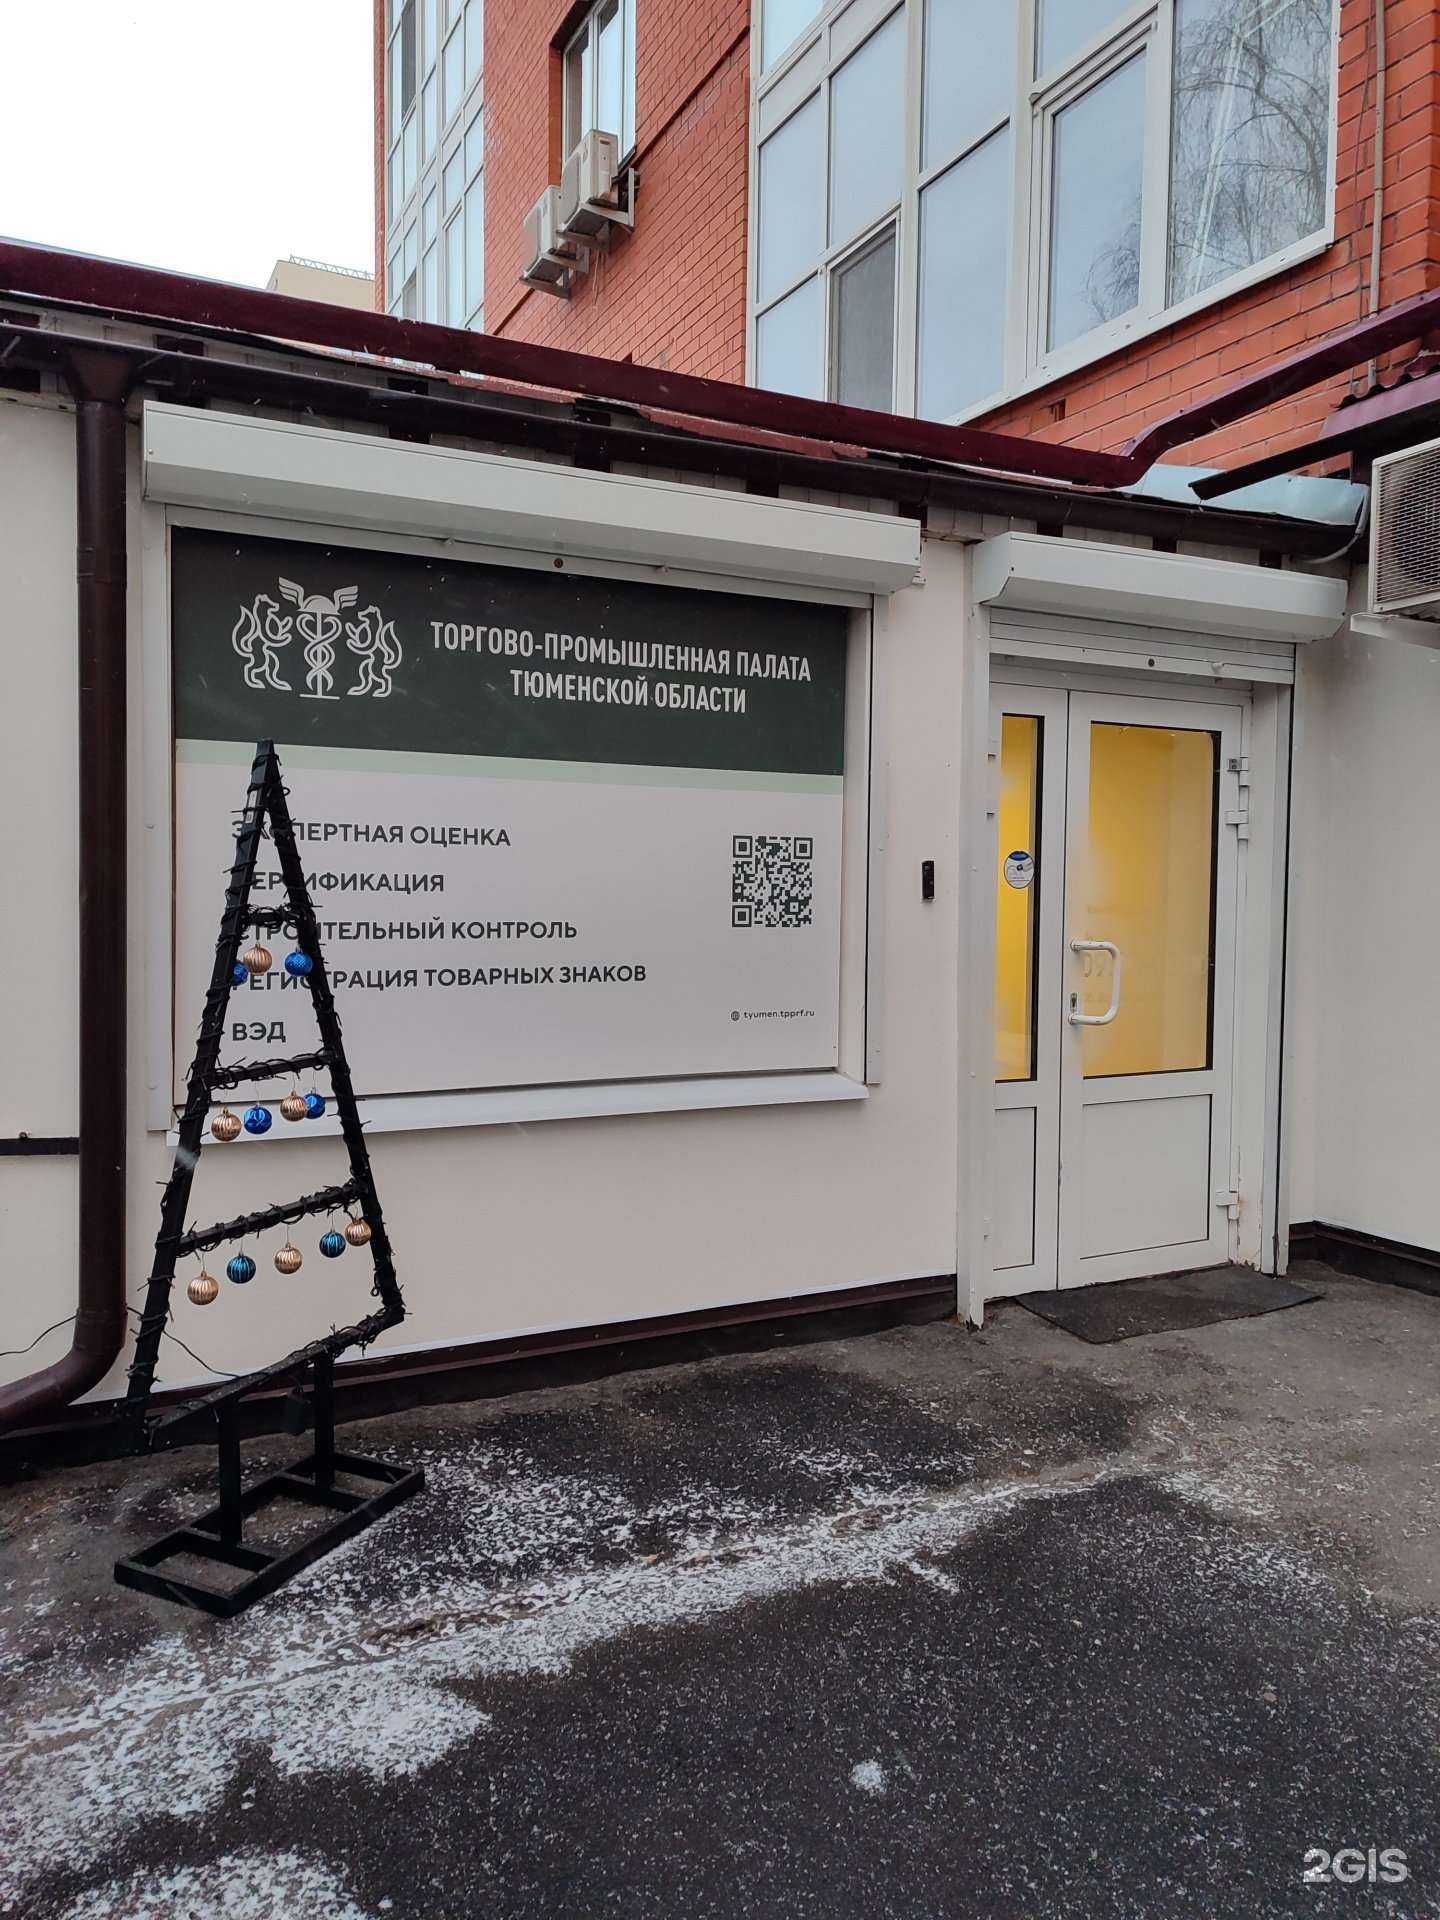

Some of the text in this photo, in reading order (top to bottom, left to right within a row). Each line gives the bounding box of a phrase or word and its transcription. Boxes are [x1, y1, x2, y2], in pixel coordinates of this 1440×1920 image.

[430, 620, 812, 682] ТОРГОВО-ПРОМЫШЛЕННАЯ ПАЛАТА
[510, 668, 747, 714] ТЮМЕНСКОЙ ОБЛАСТИ
[232, 820, 512, 848] ПЕРТНАЯ ОЦЕНКА
[237, 871, 445, 894] ЕРИФИКАЦИЯ
[451, 920, 578, 940] КОНТРОЛЬ
[232, 964, 647, 991] ЕГИРАЦИЯ ТОВАРНЫХ ЗНАКОВ
[743, 1009, 815, 1020] tyumen.tpprf.ru
[232, 1021, 287, 1044] ВЭД
